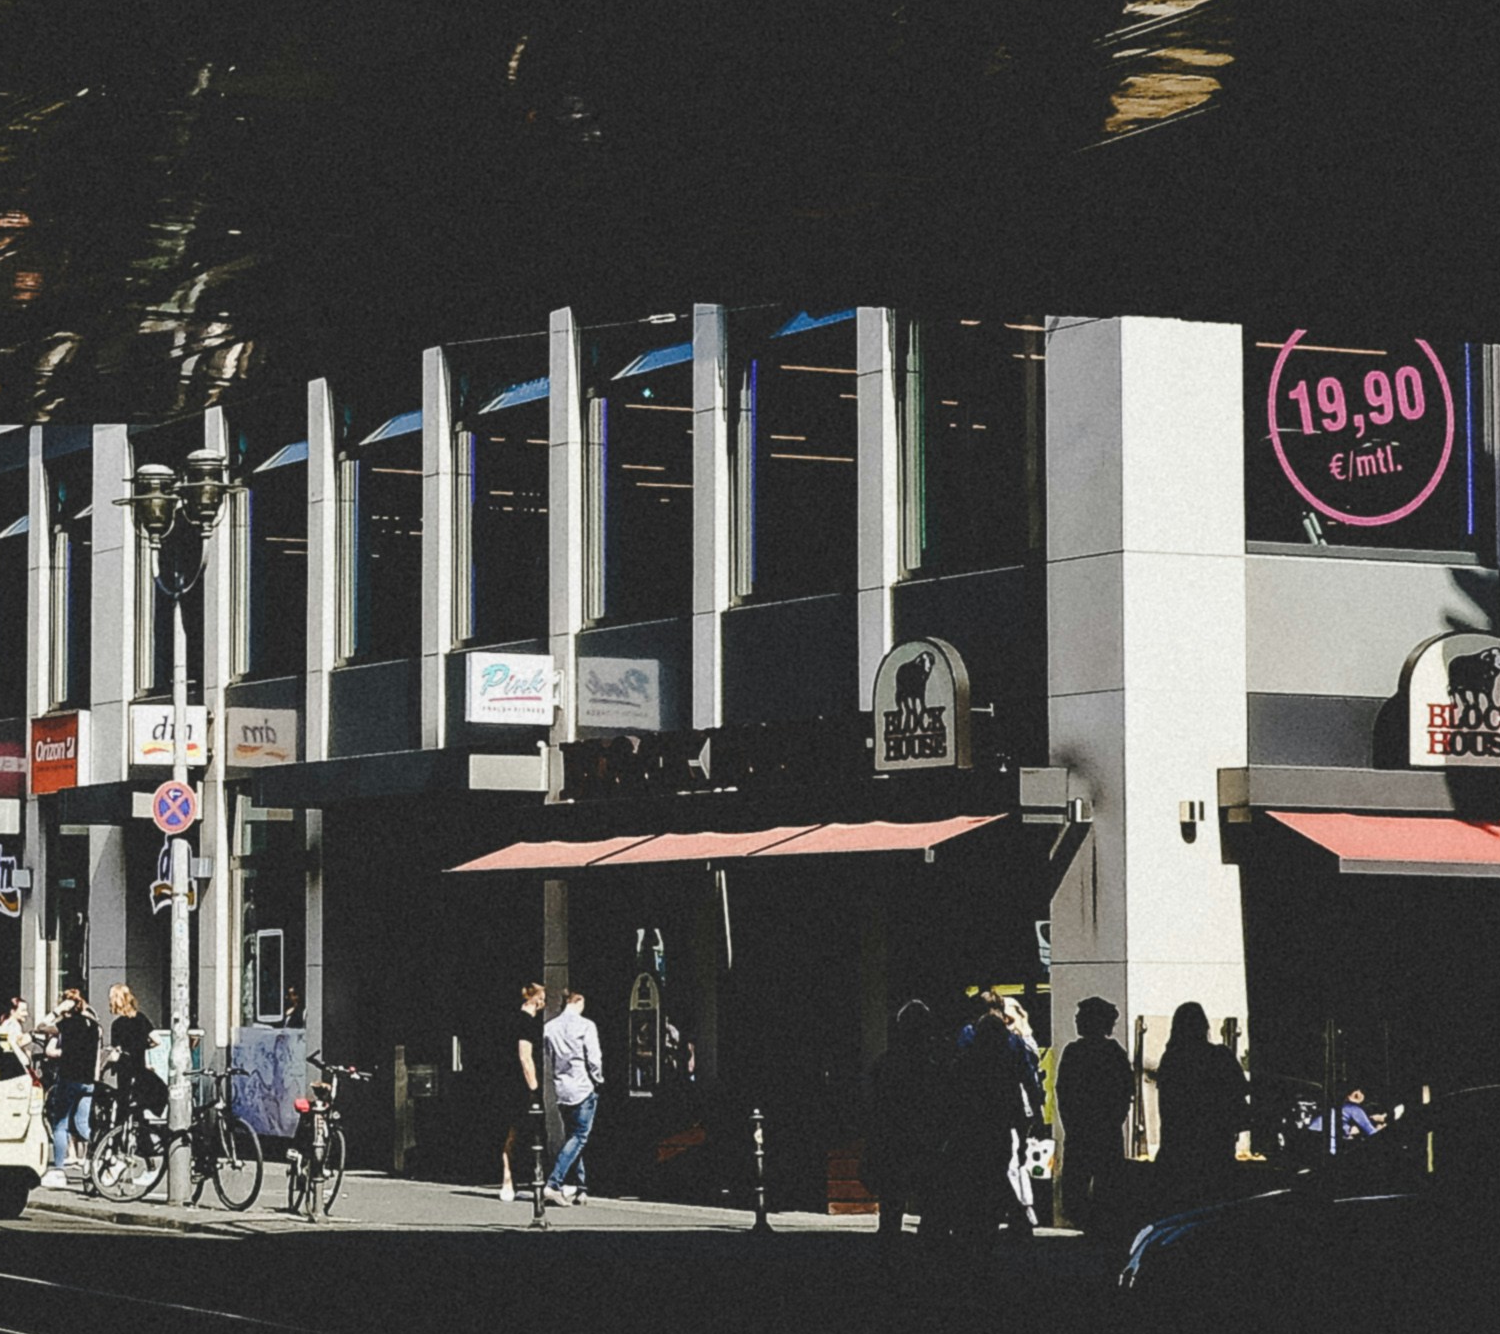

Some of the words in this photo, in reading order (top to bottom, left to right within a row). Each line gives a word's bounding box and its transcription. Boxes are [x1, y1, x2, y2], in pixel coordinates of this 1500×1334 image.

[1288, 366, 1426, 438] 19,90
[1328, 444, 1403, 482] €/mtl.
[35, 737, 66, 762] Orizon
